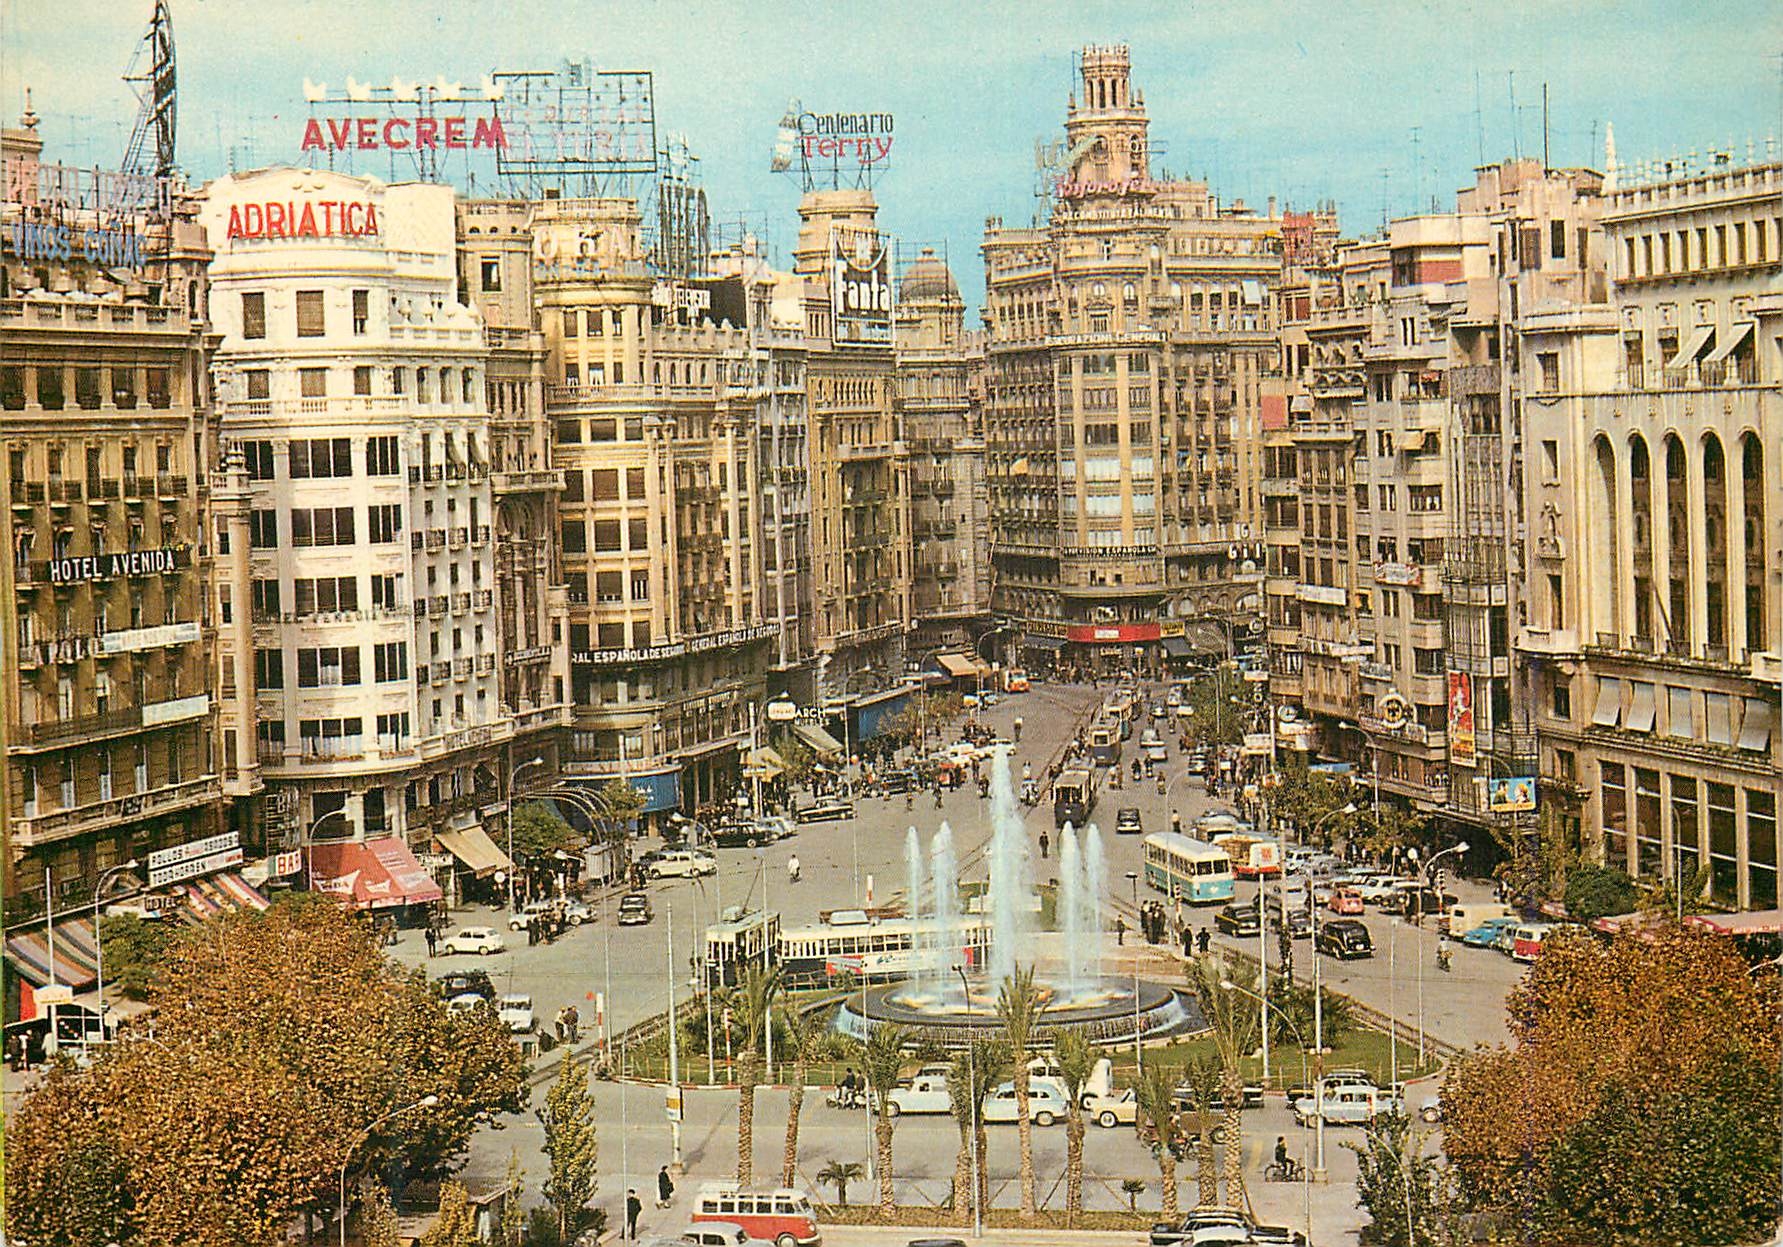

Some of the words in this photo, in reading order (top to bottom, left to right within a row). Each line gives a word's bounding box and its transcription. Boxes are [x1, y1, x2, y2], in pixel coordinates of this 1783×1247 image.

[301, 117, 511, 151] AVECREM
[797, 112, 894, 135] Centenario
[799, 136, 894, 165] Terry
[227, 201, 379, 240] ADRIATICA
[12, 222, 71, 261] VINOS
[835, 259, 890, 314] Fanta
[50, 557, 102, 582] HOTEL
[112, 550, 175, 576] AVENIDA
[593, 648, 649, 663] ESPAÑOLA
[794, 707, 826, 718] ARCH
[145, 897, 177, 911] HOTEL
